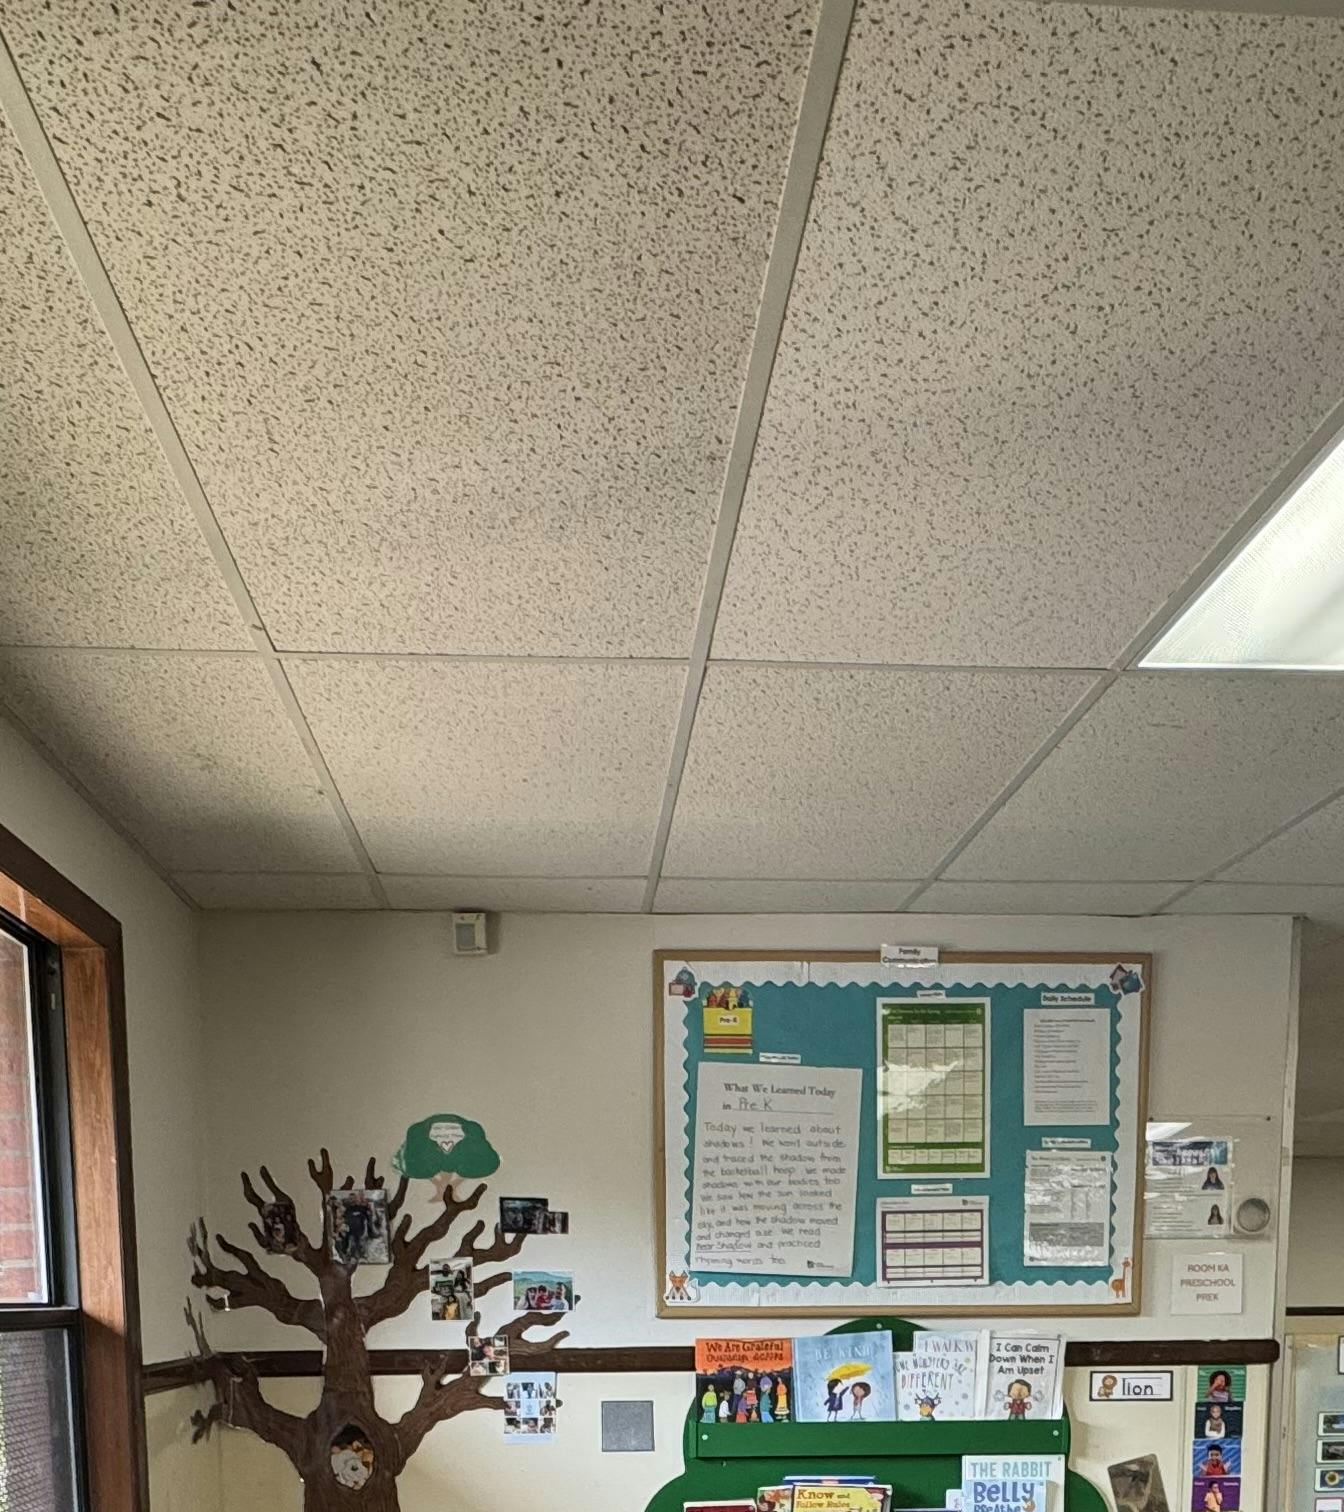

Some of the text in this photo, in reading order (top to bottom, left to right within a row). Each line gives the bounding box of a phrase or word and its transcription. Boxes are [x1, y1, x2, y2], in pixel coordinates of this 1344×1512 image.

[724, 1083, 836, 1099] What We Learned Today
[704, 1121, 737, 1137] Today
[760, 1122, 801, 1134] learned
[809, 1125, 841, 1134] about
[779, 1138, 801, 1147] went
[702, 1152, 841, 1163] and traced the shadow from
[702, 1165, 846, 1177] the basketball made
[702, 1181, 738, 1190] shadows
[739, 1191, 754, 1199] how
[758, 1190, 772, 1198] the
[799, 1189, 832, 1198] looked
[700, 1206, 715, 1216] like
[720, 1205, 726, 1214] it
[753, 1204, 787, 1216] moving
[792, 1203, 823, 1211] across
[829, 1202, 842, 1210] the
[716, 1216, 839, 1227] and how the shadow moved
[696, 1227, 821, 1242] and changed read
[757, 1241, 773, 1249] and
[778, 1240, 821, 1250] practiced
[1187, 1264, 1216, 1273] ROOM
[1180, 1279, 1236, 1287] PRESCHOOL
[706, 1341, 784, 1353] We Are Grateful
[996, 1343, 1050, 1353] I Can Calm
[989, 1354, 1055, 1364] Down When I
[998, 1366, 1045, 1376] Am Upset
[901, 1371, 954, 1390] DIFFERENT
[1122, 1378, 1154, 1396] lion
[971, 1461, 1052, 1478] THE RABBIT
[797, 1489, 834, 1500] Know
